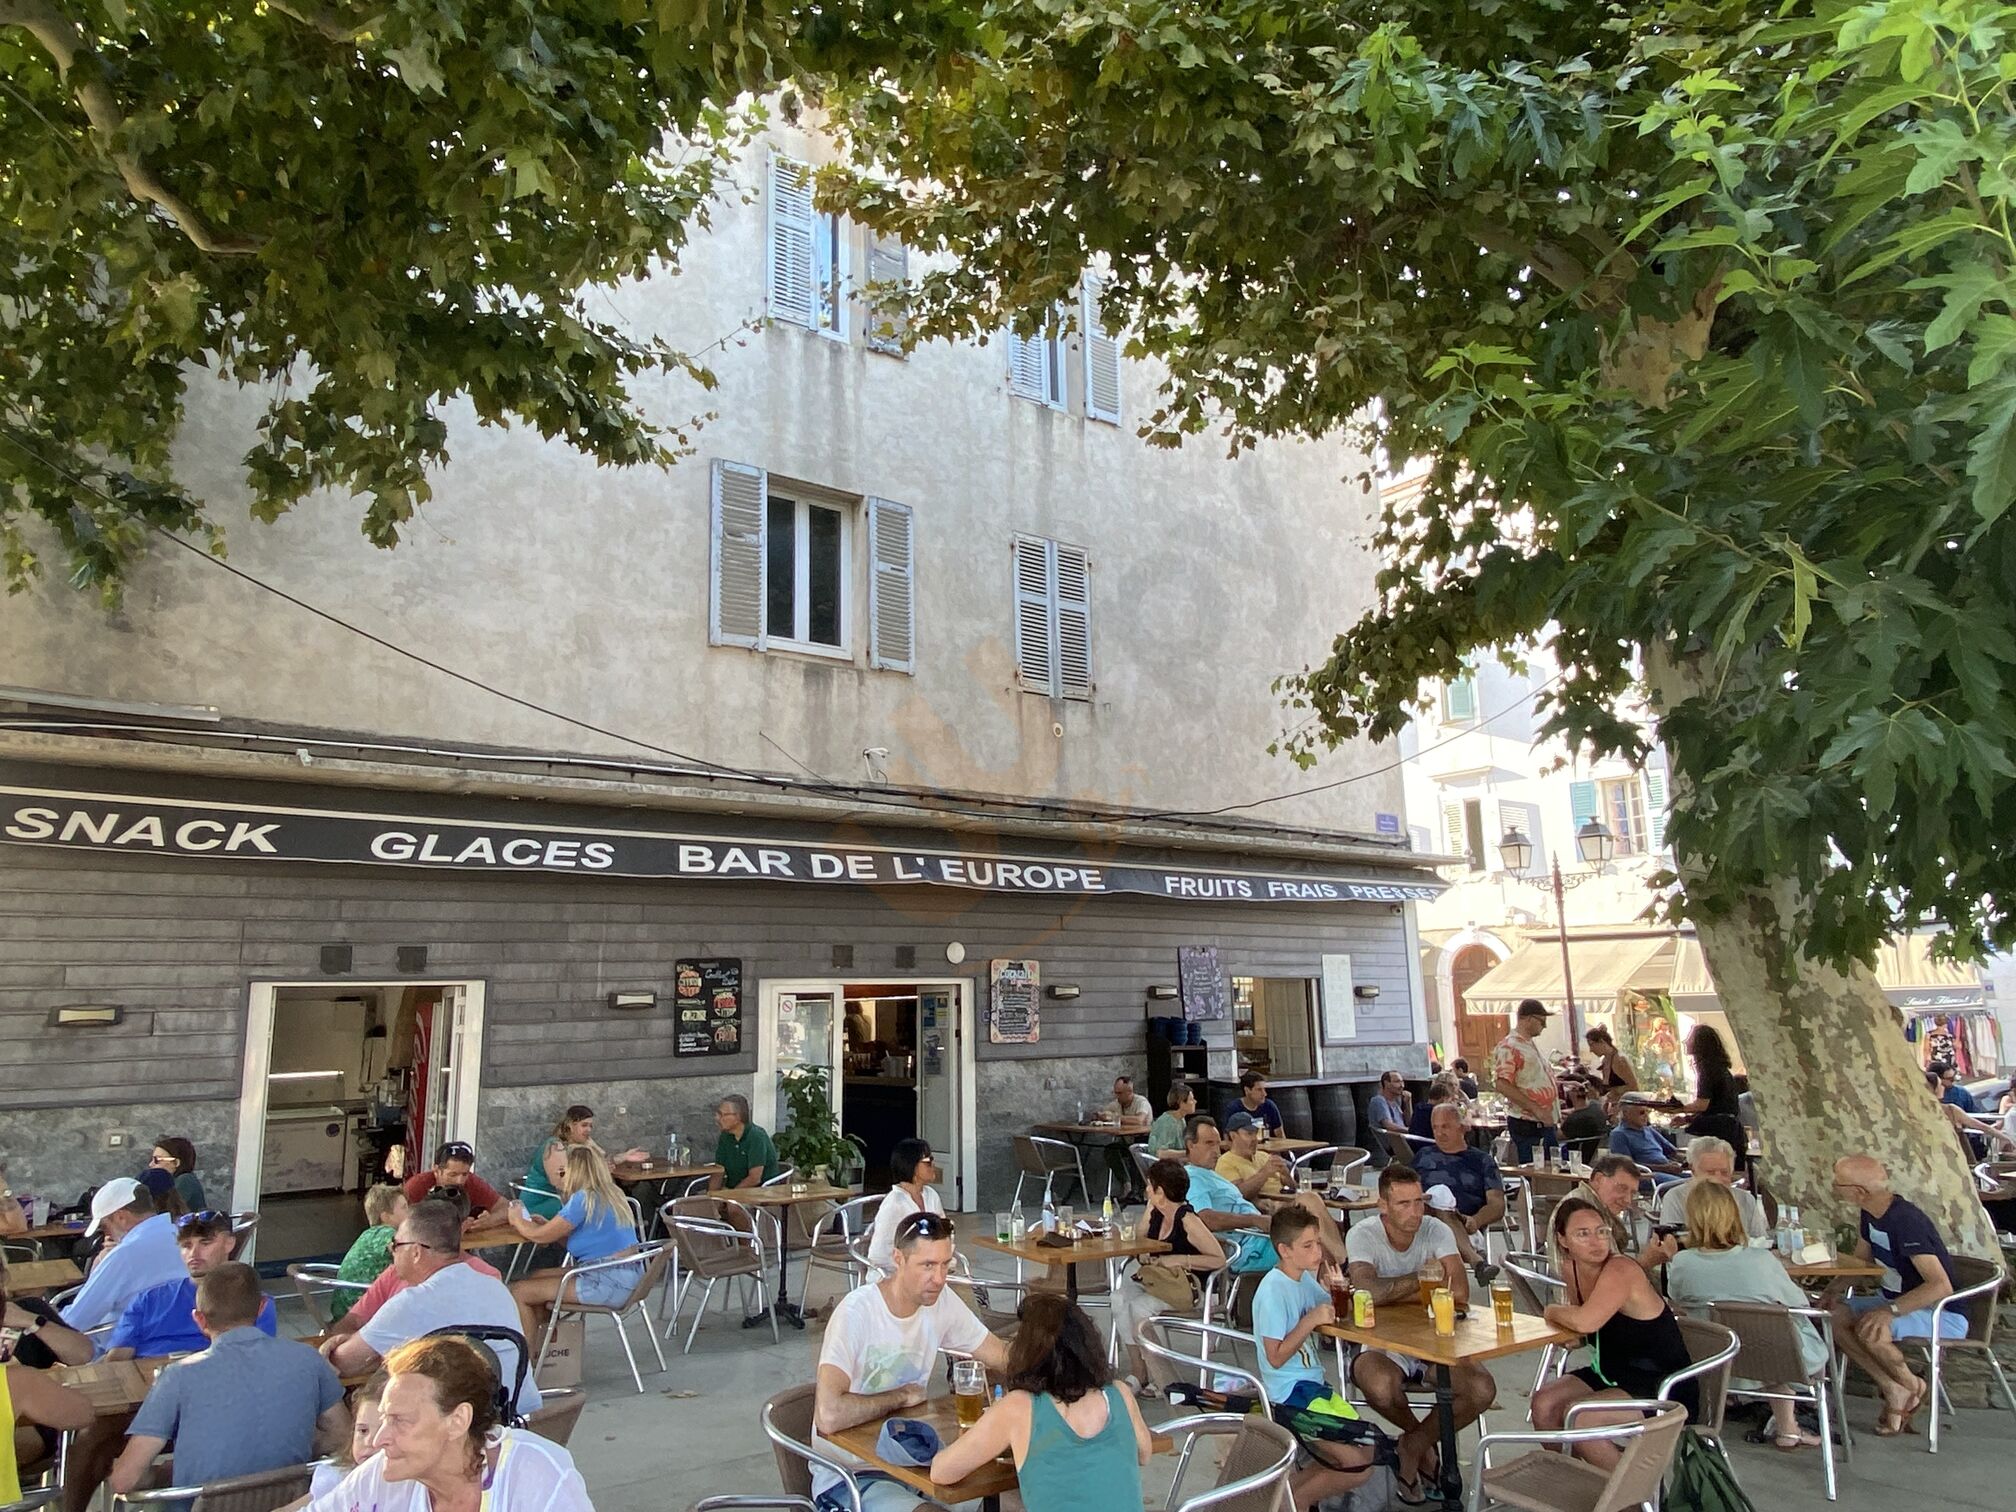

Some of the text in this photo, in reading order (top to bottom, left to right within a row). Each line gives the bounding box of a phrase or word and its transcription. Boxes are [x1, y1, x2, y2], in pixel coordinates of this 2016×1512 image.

[5, 807, 281, 853] SNACK
[370, 831, 615, 868] GLACES
[678, 844, 795, 876] BAR
[810, 853, 878, 879] DE
[1164, 876, 1252, 897] FRUITS
[1267, 881, 1338, 898] FRAIS
